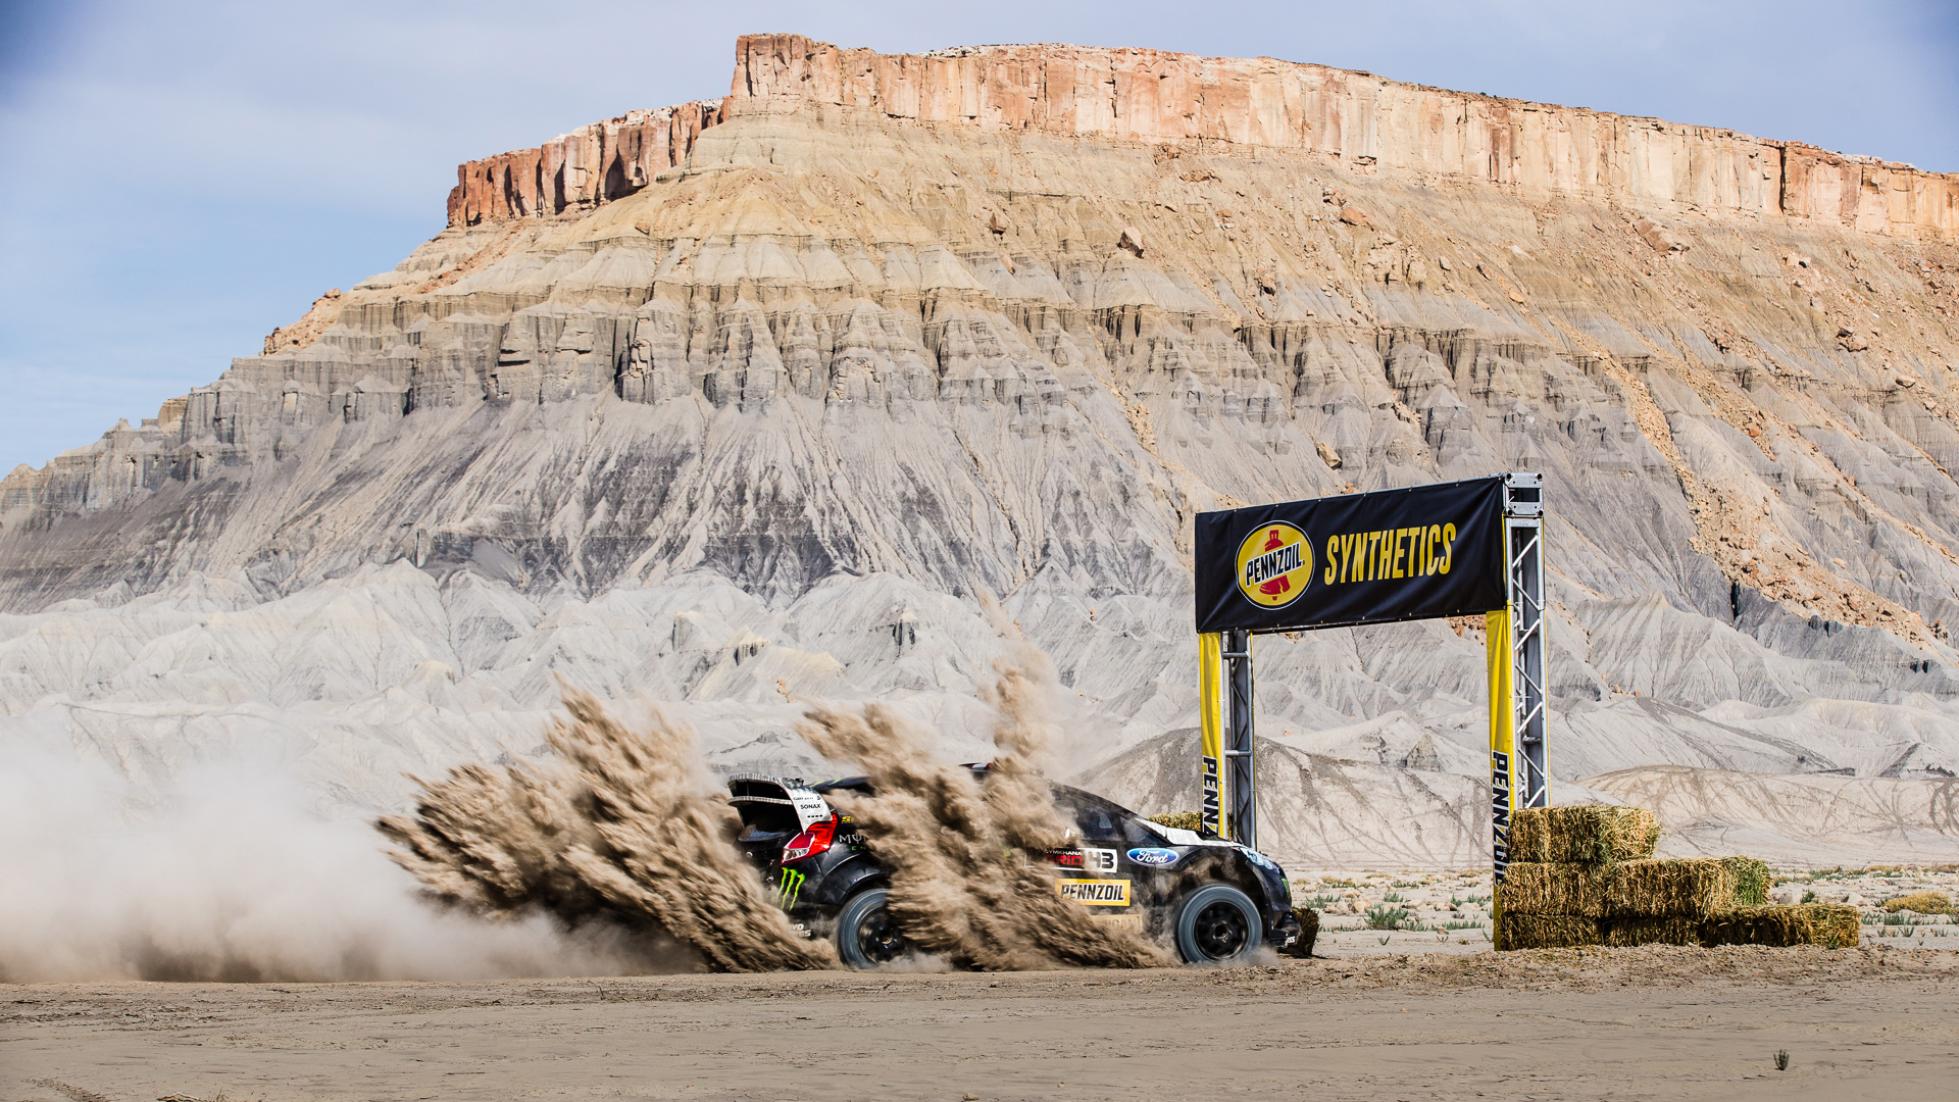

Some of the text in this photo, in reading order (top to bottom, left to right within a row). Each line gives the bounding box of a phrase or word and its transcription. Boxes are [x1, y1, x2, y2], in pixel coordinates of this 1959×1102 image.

[1246, 522, 1457, 586] PENNZOIL SYNTHETICS
[1087, 851, 1115, 869] 43
[1136, 850, 1169, 863] Ford
[1061, 884, 1124, 901] PENNZOIL
